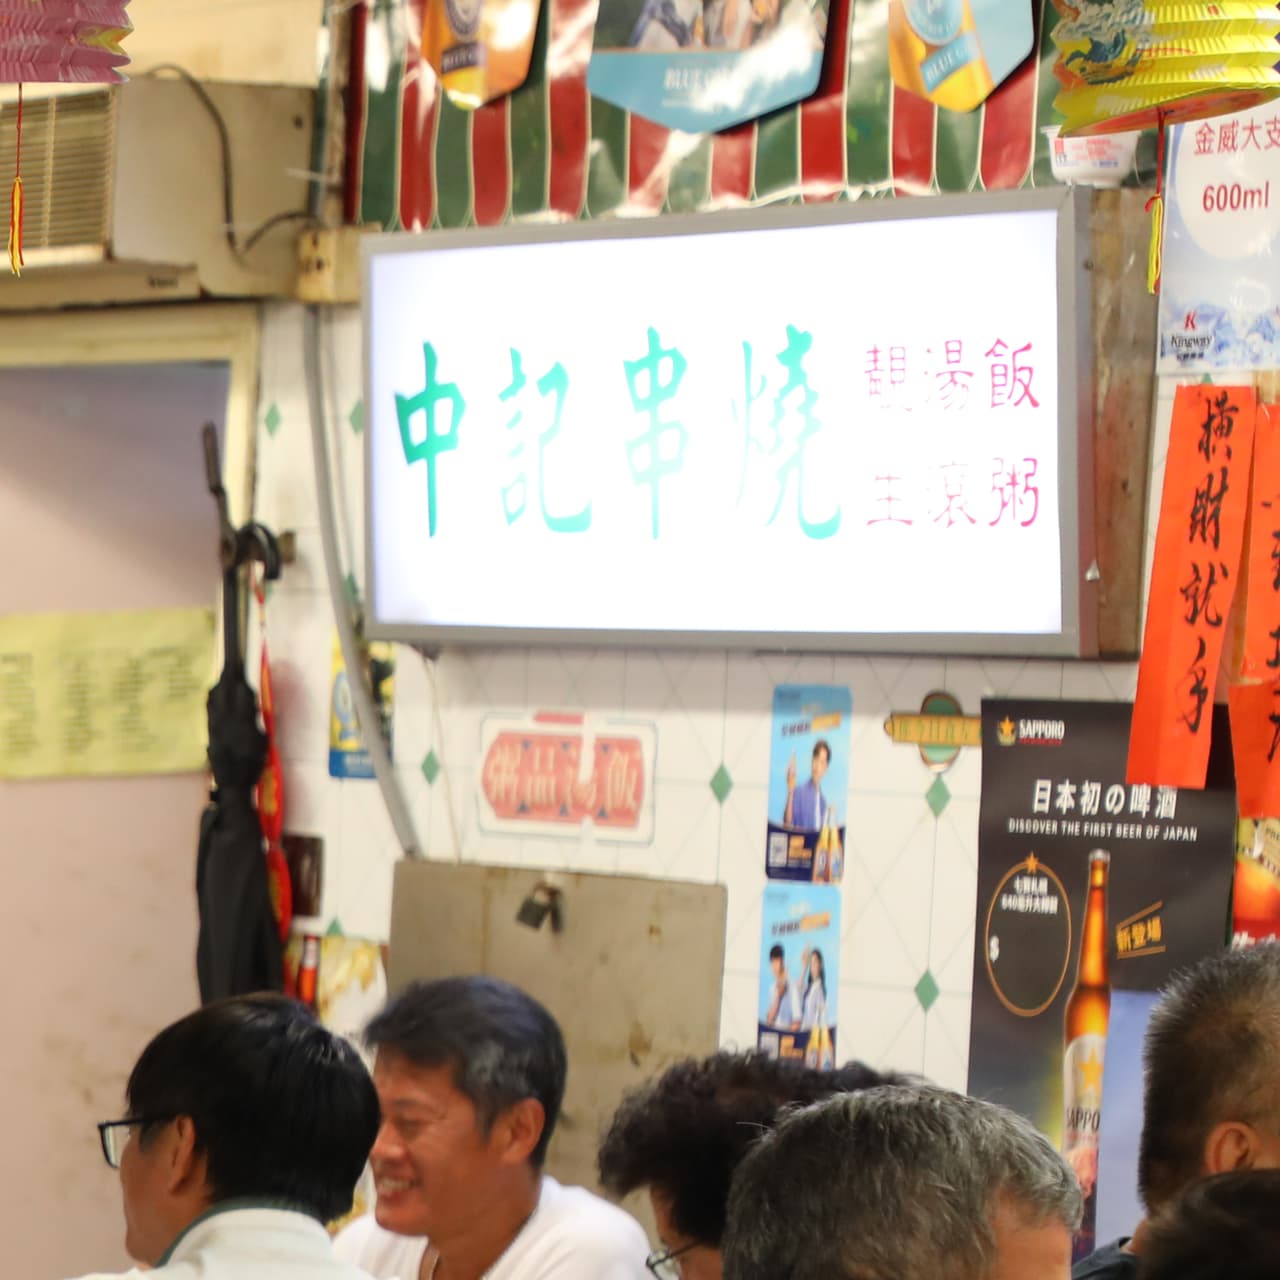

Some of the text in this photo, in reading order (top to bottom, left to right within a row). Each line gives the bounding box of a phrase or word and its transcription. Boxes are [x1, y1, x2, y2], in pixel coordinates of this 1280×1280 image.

[1194, 116, 1280, 156] 金威大支
[1202, 181, 1270, 213] 600ml
[864, 338, 1040, 412] 靚湯飯
[394, 324, 842, 540] 中記串燒
[1179, 390, 1240, 735] 橫財就手
[1019, 718, 1065, 740] SAPPORO
[1032, 778, 1178, 820] 日本初の啤酒
[1008, 818, 1198, 842] DISCOVER THE FIRST BEER OF JAPAN
